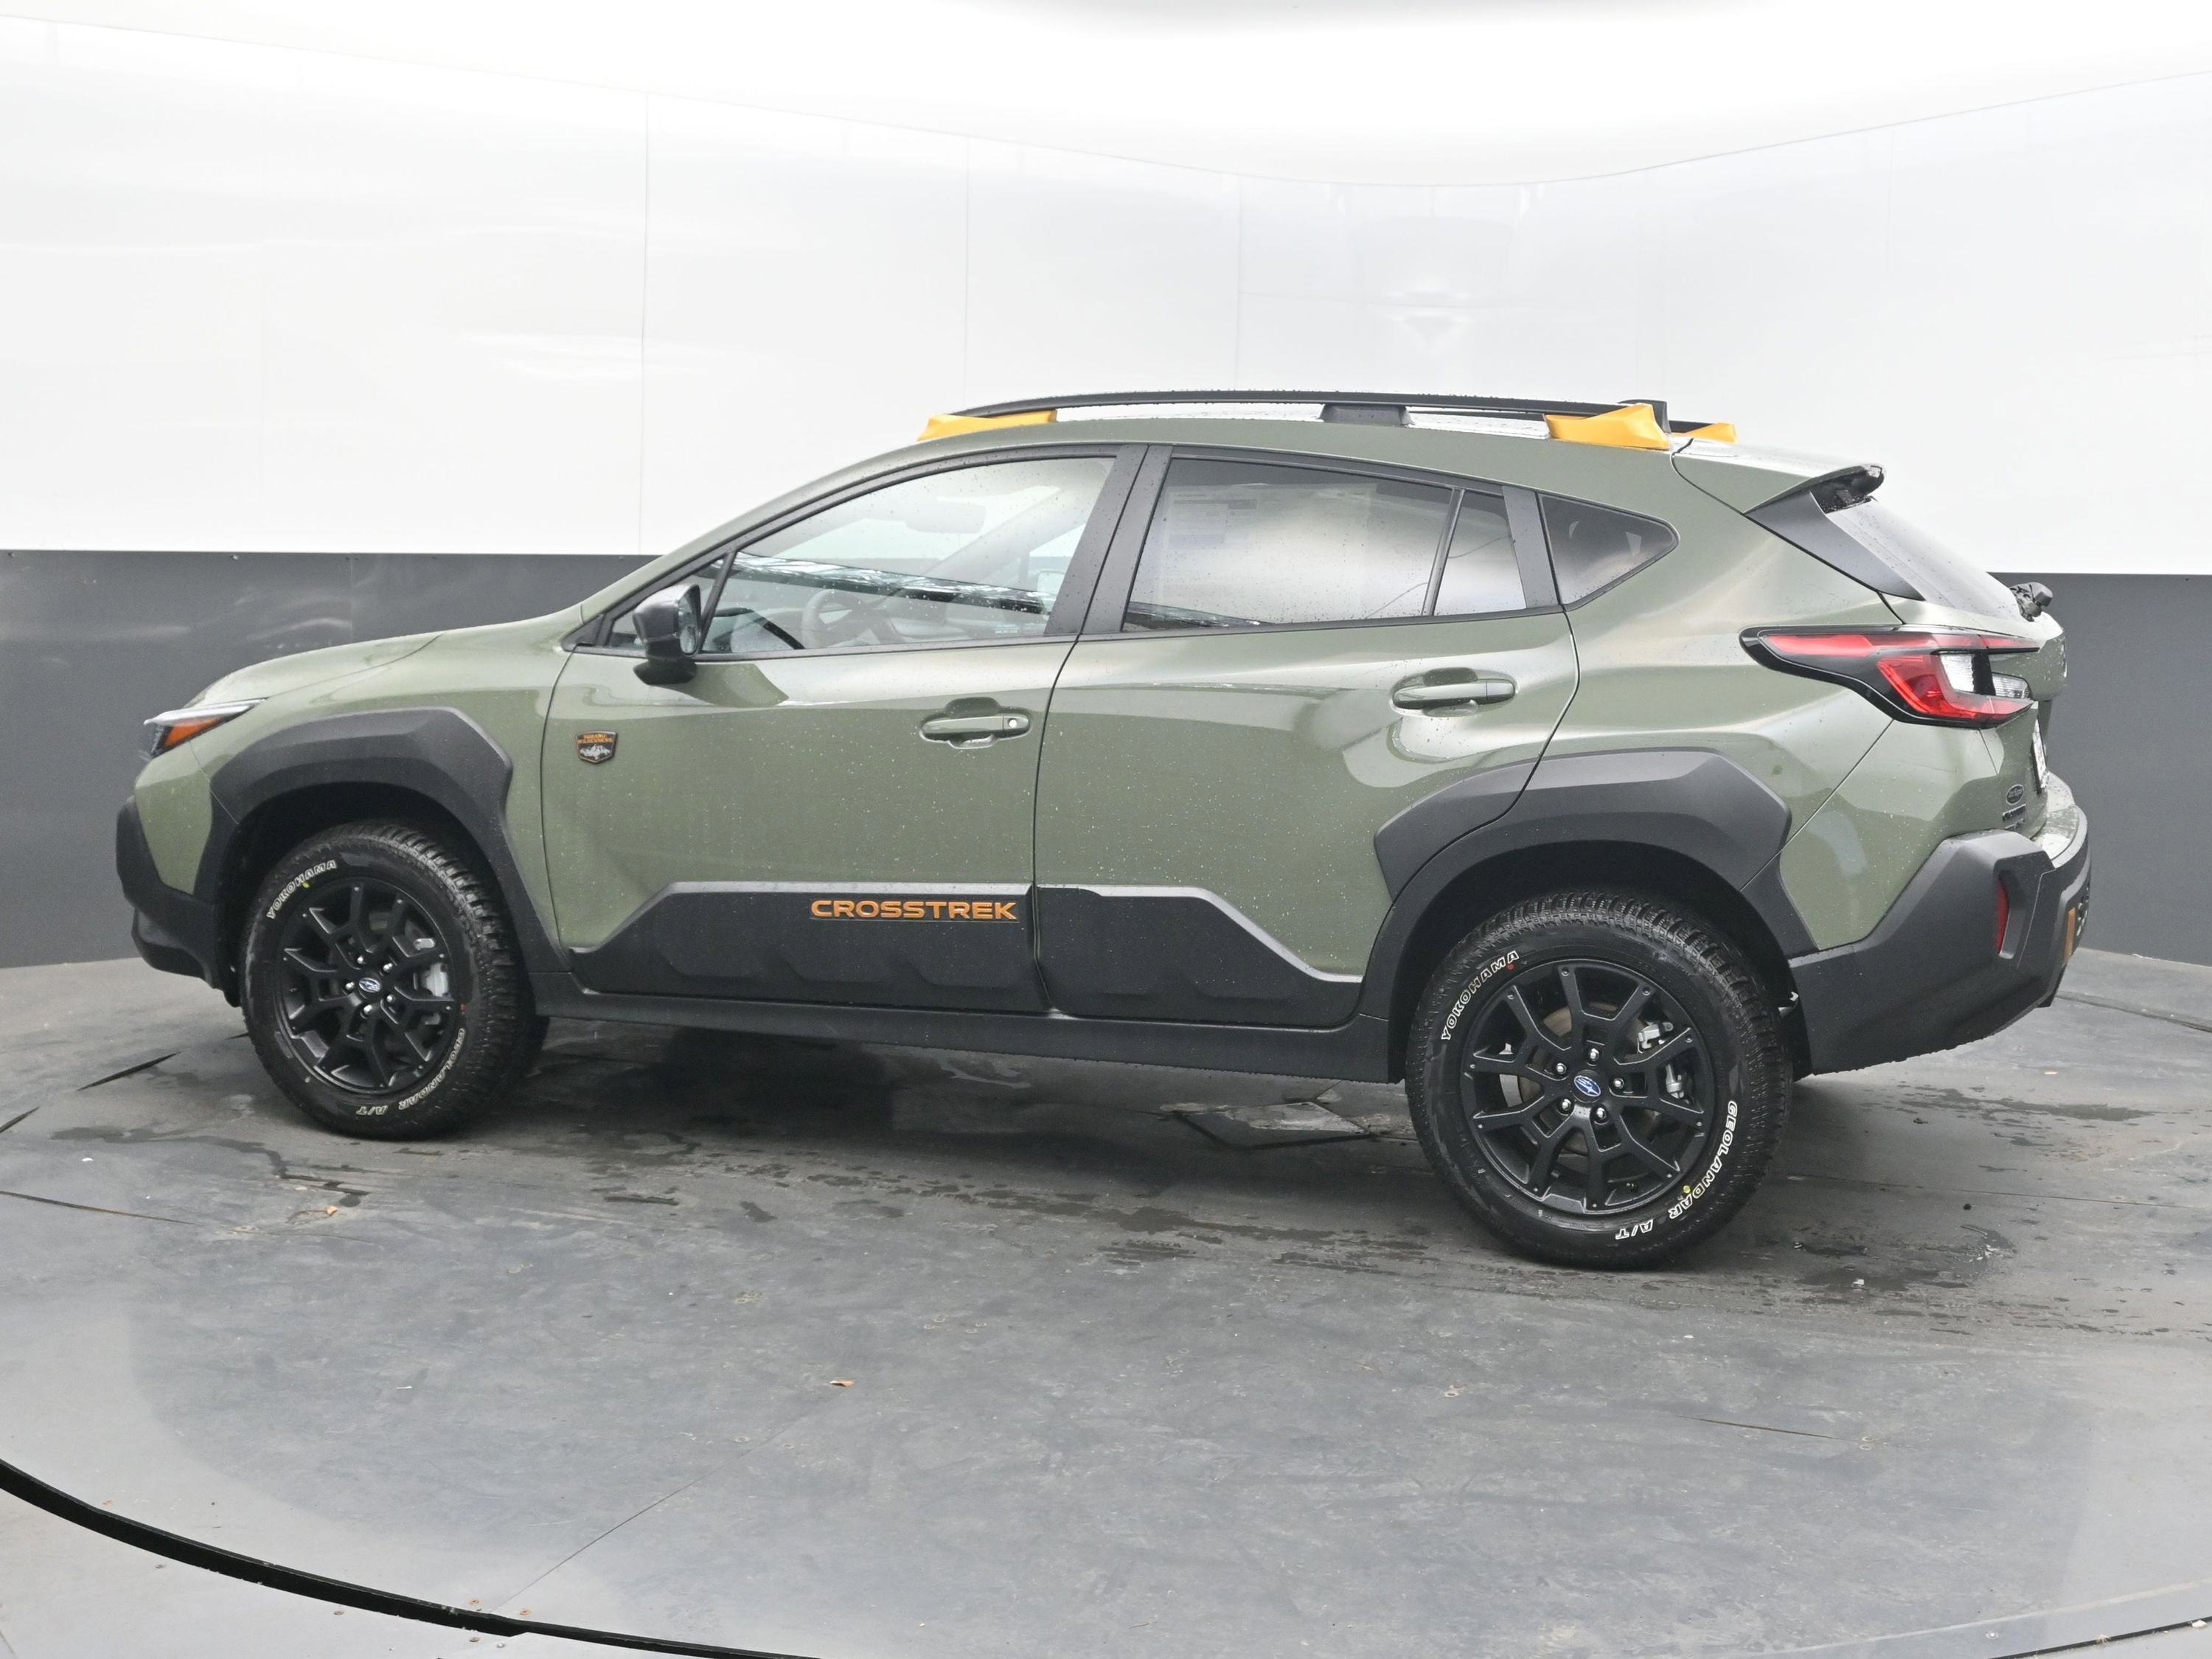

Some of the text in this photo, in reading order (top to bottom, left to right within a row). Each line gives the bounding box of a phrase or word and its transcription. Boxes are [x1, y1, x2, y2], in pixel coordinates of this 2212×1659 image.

[266, 860, 337, 919] YOKOHAMA
[810, 900, 1018, 920] CROSSTREK
[1441, 950, 1520, 1040] YOKOHAMA
[356, 1028, 465, 1116] GEOLANDAR A/T
[1615, 1100, 1738, 1240] GEOLANDAR A/T
